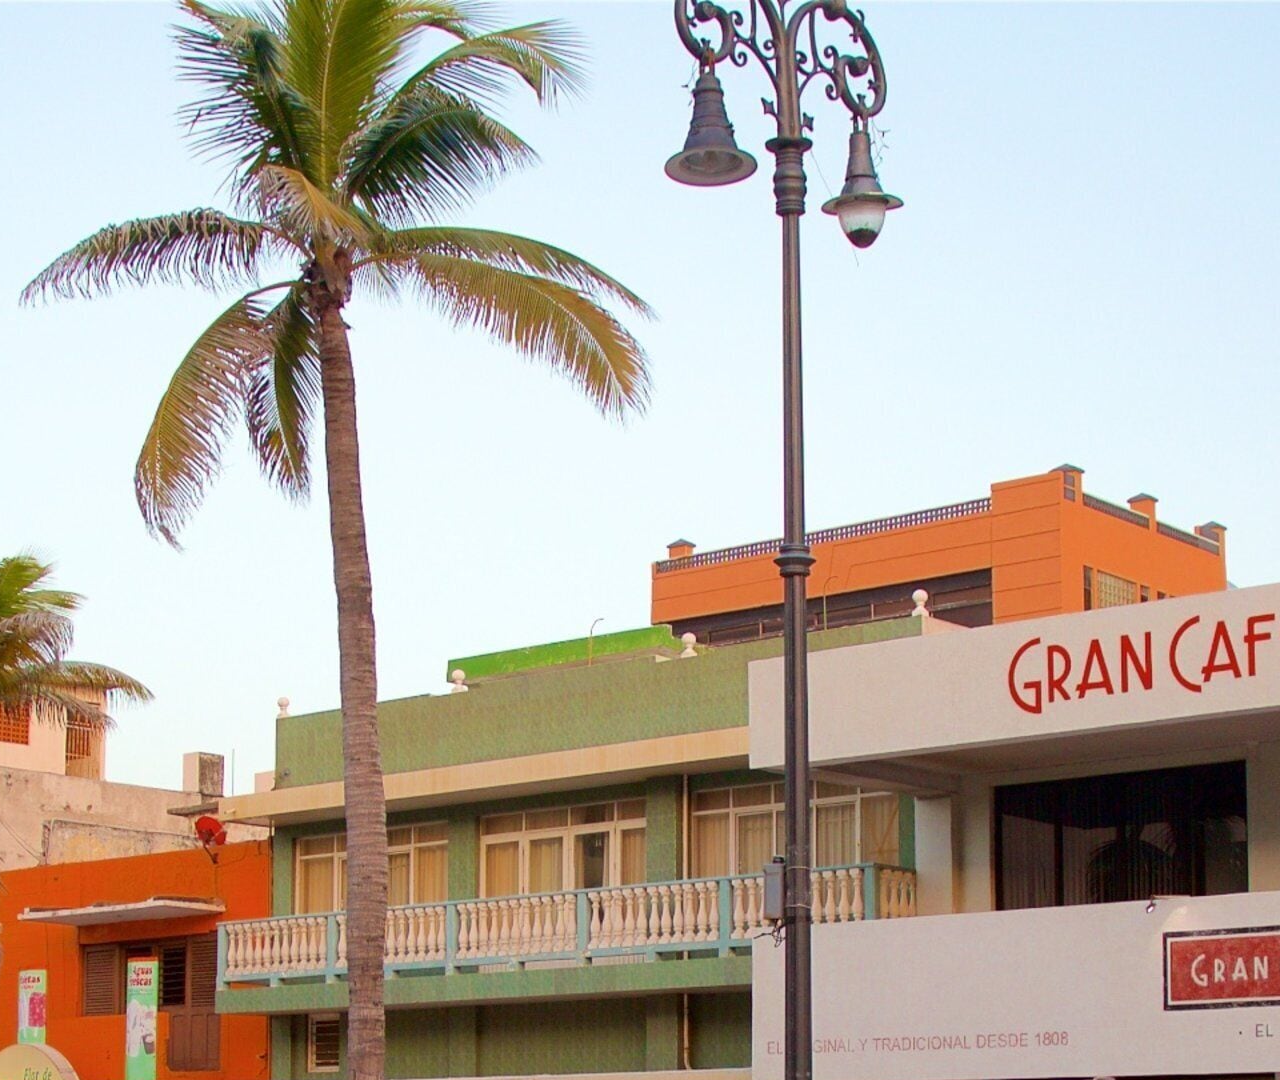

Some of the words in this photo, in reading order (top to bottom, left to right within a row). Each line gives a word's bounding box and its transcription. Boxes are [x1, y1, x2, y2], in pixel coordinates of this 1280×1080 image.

[1008, 631, 1153, 714] GRAN
[1191, 954, 1269, 987] GRAN
[1255, 1023, 1274, 1038] EL
[767, 1041, 783, 1055] EL
[857, 1038, 868, 1051] Y
[872, 1035, 971, 1052] TRADICIONAL
[976, 1033, 1029, 1049] DESDE
[1034, 1031, 1069, 1046] 1808
[43, 1067, 52, 1080] de
